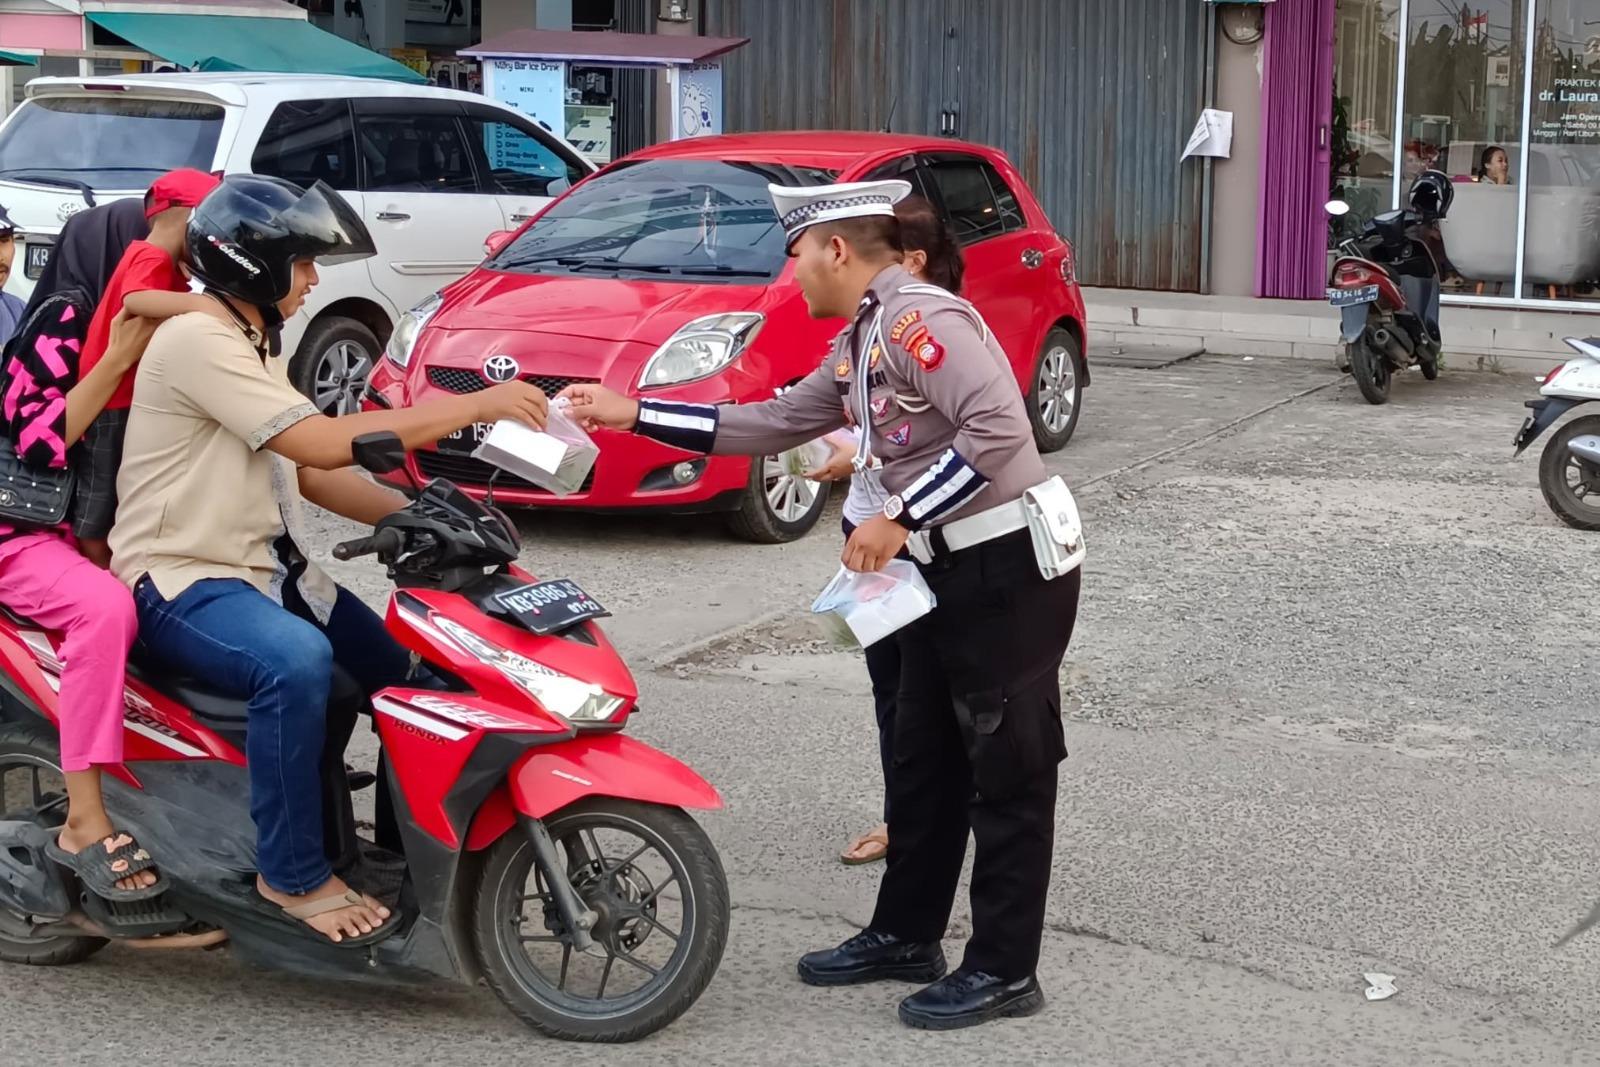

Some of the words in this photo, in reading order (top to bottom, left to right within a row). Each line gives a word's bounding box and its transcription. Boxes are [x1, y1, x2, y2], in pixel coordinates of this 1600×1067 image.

[1554, 78, 1597, 88] PRAKTEK
[1538, 89, 1556, 102] dr.
[1560, 89, 1598, 102] Laura
[32, 248, 49, 266] KB
[394, 719, 448, 746] HONDA
